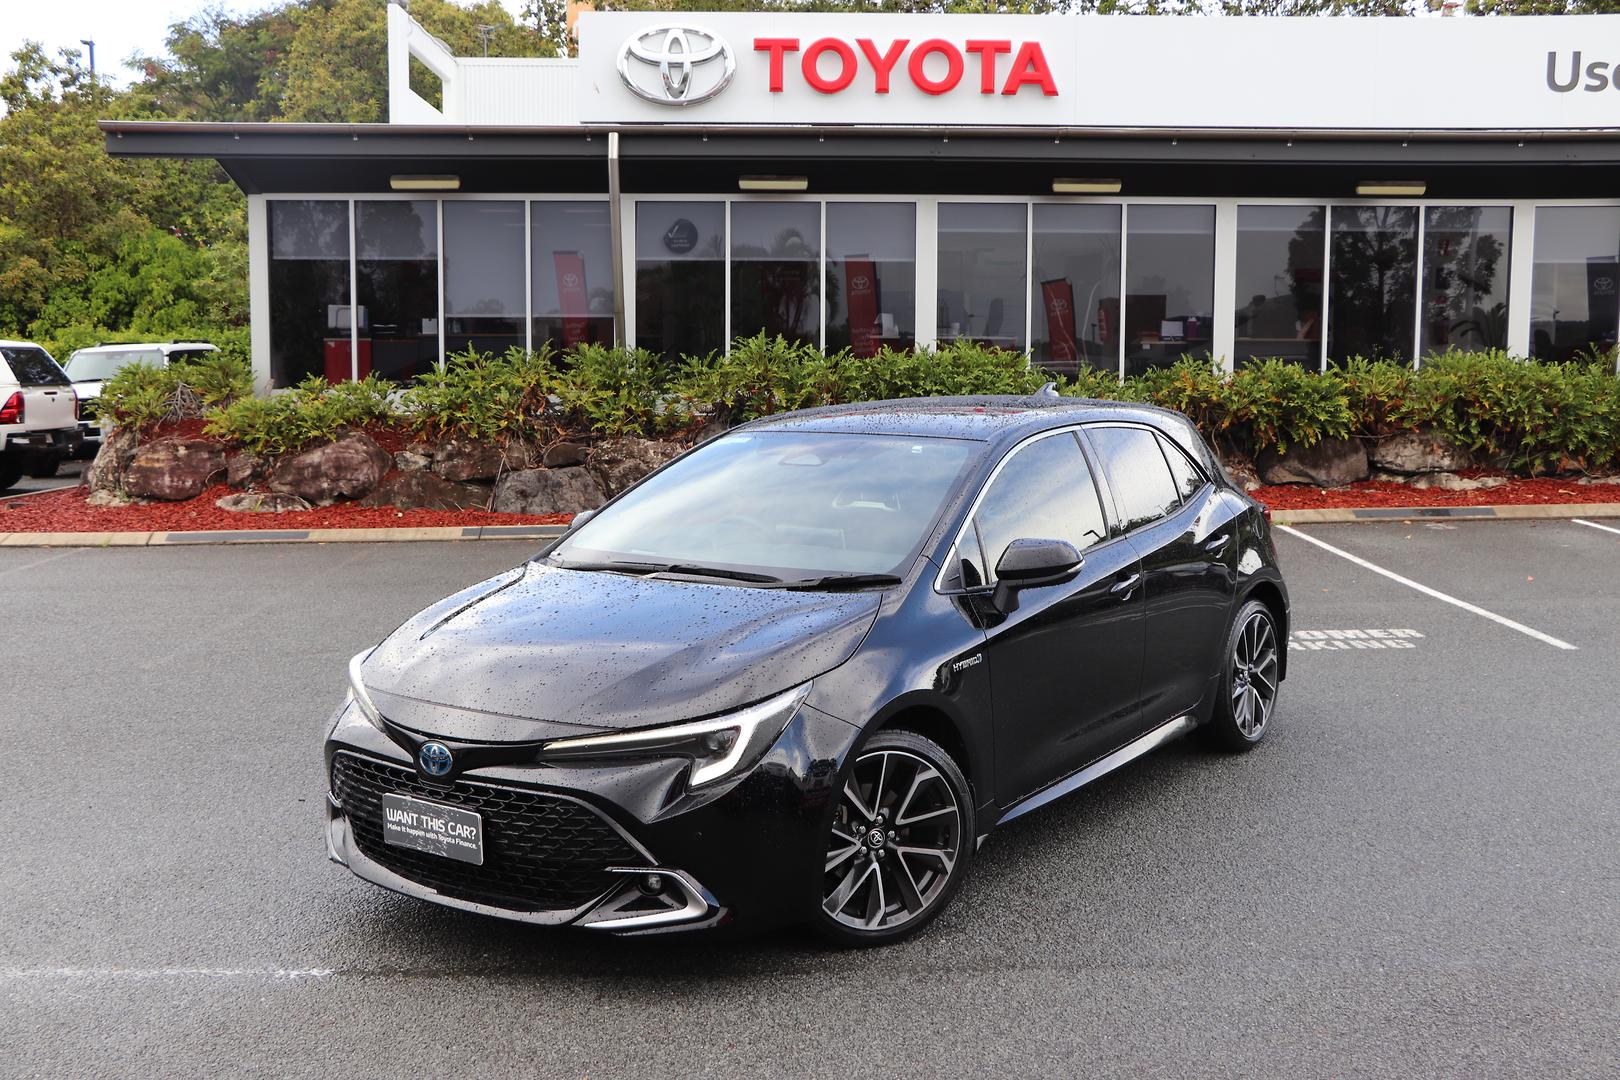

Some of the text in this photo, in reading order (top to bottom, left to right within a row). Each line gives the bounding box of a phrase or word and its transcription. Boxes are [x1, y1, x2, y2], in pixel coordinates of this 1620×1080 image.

[753, 37, 1059, 97] TOYOTA
[386, 808, 476, 839] WANT THIS CAR?
[387, 822, 478, 850] Make it happen with Toyota Finance.
